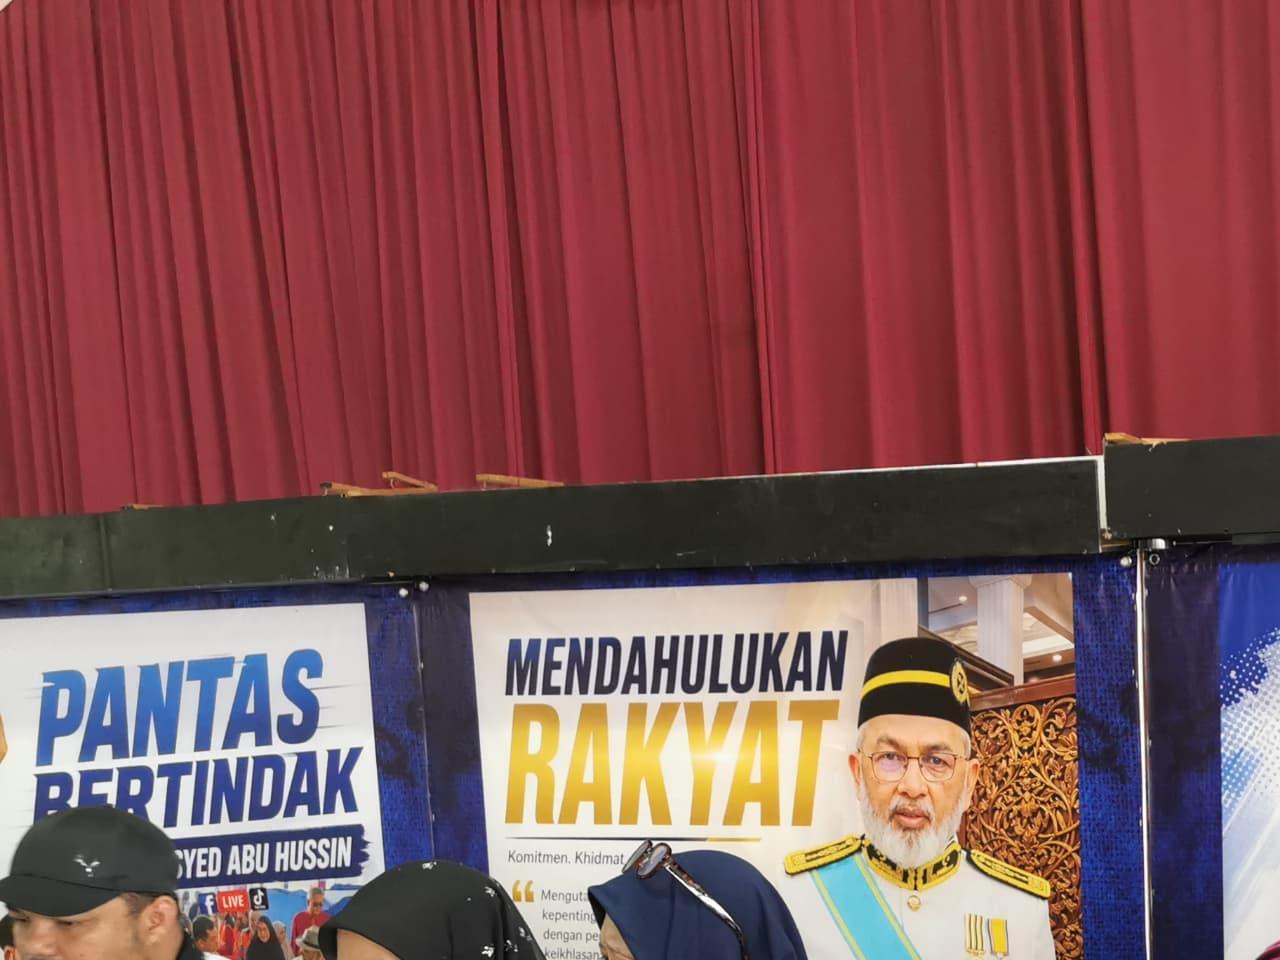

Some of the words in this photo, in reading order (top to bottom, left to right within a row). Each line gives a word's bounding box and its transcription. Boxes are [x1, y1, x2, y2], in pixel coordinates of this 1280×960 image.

[505, 631, 848, 696] MENDAHULUKAN
[36, 649, 324, 766] PANTAS
[33, 747, 363, 828] BERTINDAK
[505, 700, 839, 827] RAKYAT
[227, 842, 270, 876] ABU
[274, 835, 353, 872] HUSSIN
[508, 849, 571, 865] Komitmen.
[575, 850, 624, 866] Khidmat
[222, 895, 245, 909] LIVE
[543, 928, 583, 943] dengan
